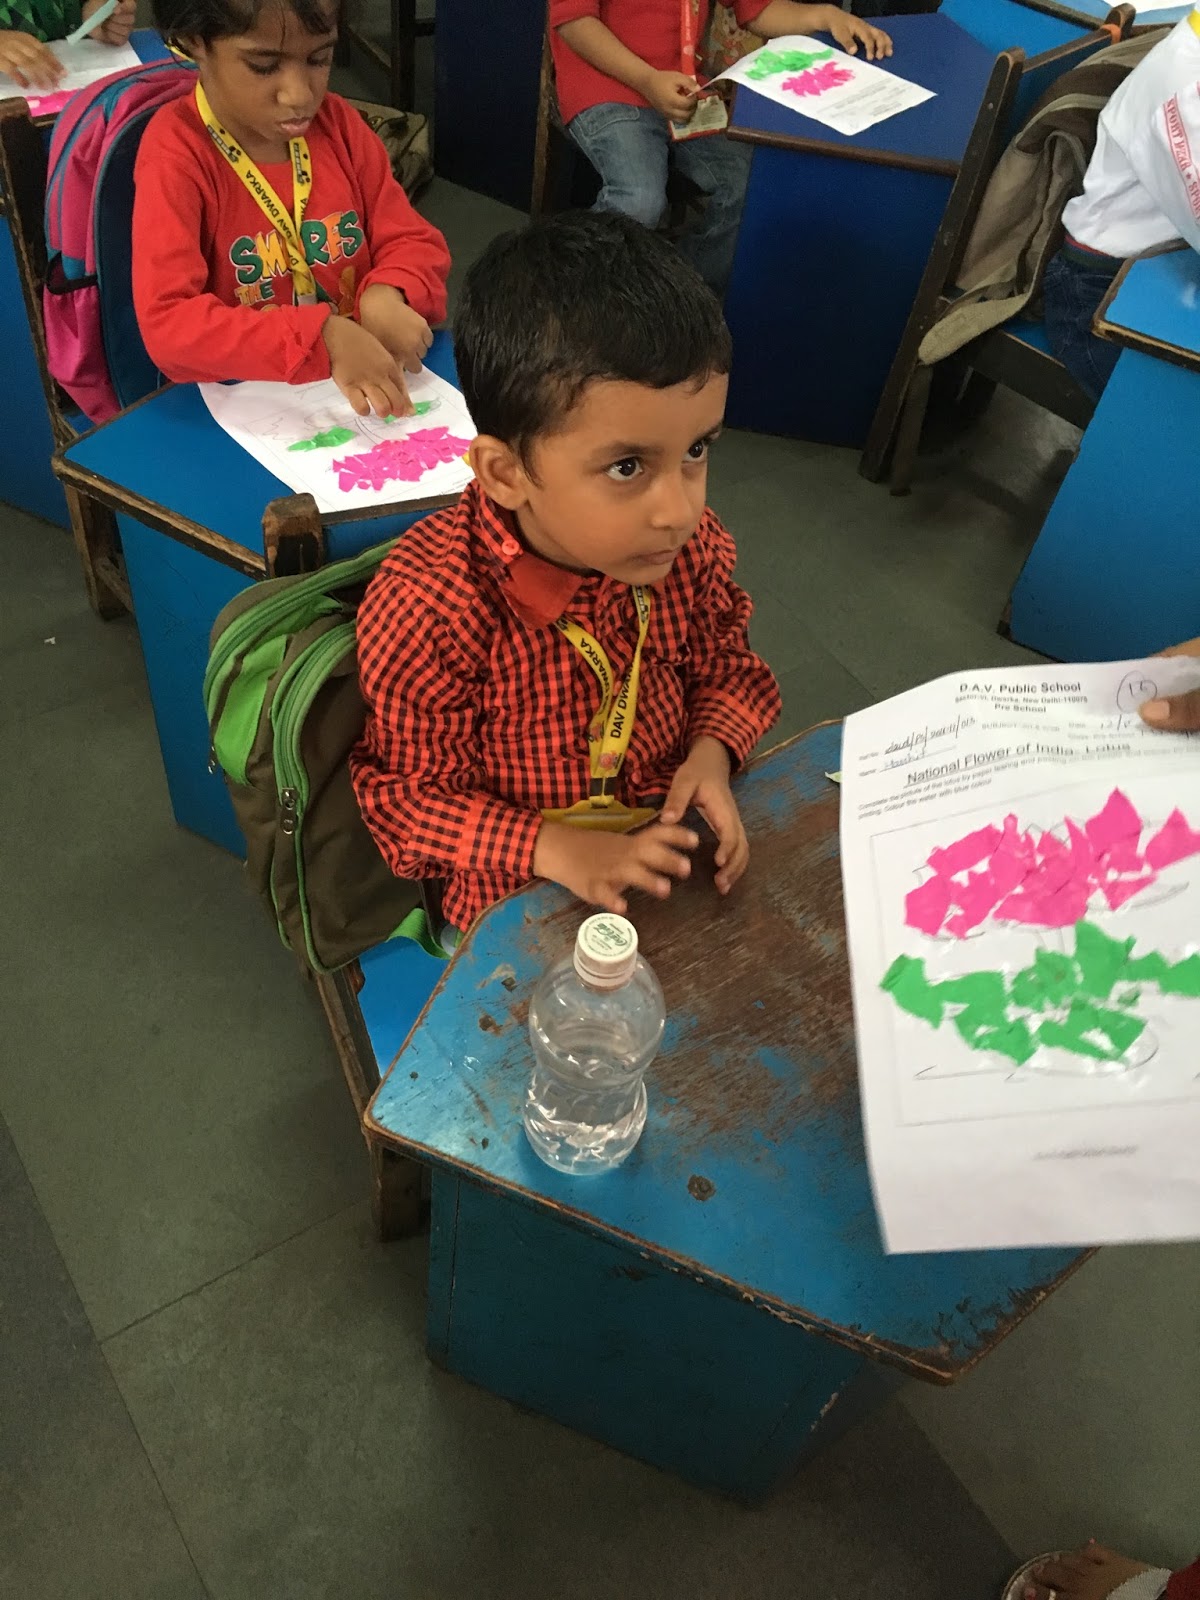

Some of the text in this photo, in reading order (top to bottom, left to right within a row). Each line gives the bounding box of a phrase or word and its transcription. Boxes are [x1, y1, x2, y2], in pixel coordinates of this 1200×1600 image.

[245, 169, 282, 219] DWARKA
[234, 280, 275, 306] THE
[1000, 683, 1037, 694] Public
[1041, 681, 1081, 694] School
[995, 703, 1047, 713] Pre School
[610, 711, 627, 739] DAV
[907, 758, 960, 784] National
[964, 746, 1010, 768] Flower
[1016, 743, 1030, 756] of
